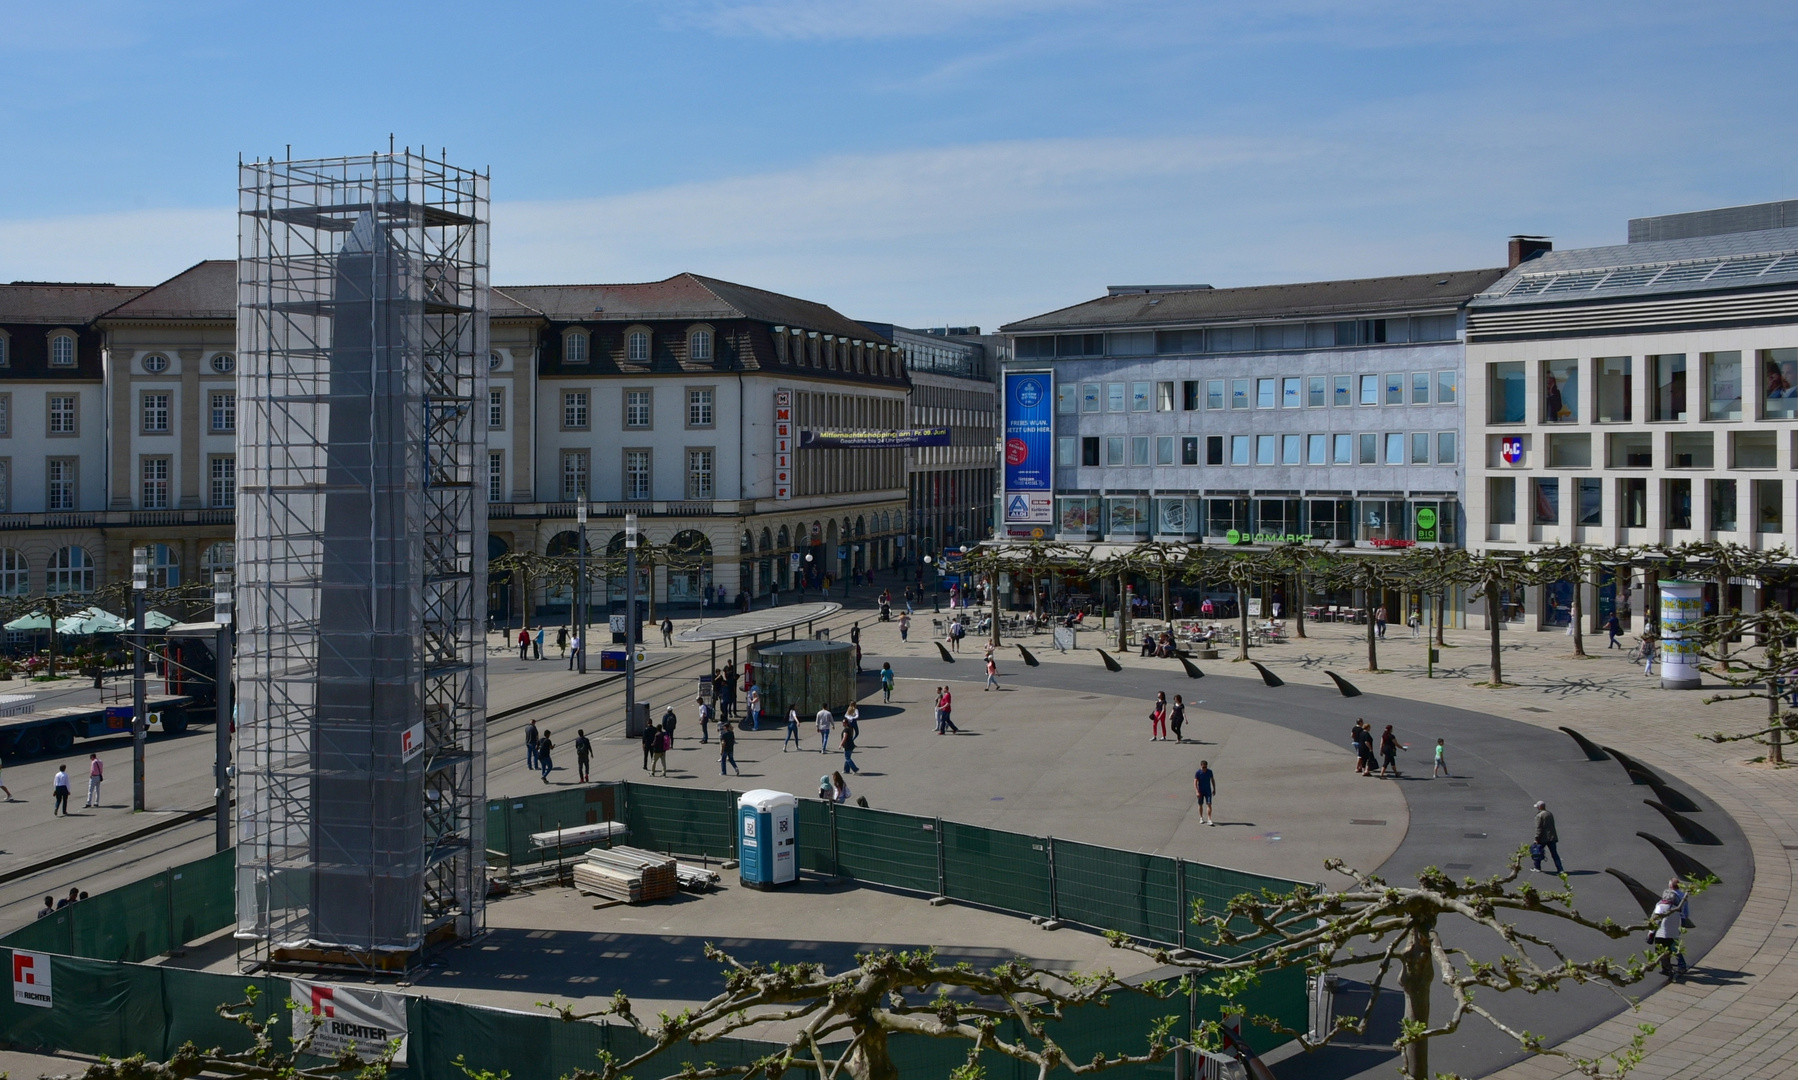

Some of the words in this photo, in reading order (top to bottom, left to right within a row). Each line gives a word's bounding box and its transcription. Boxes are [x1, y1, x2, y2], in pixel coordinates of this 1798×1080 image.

[777, 409, 789, 496] Müller
[1503, 442, 1520, 455] P&C
[1007, 529, 1031, 537] Kamps
[1242, 533, 1314, 543] BIOMARKT
[1370, 536, 1416, 548] Sparkasse
[24, 991, 52, 1003] RICHTER
[332, 1021, 388, 1041] RICHTER
[319, 1034, 339, 1042] Richter
